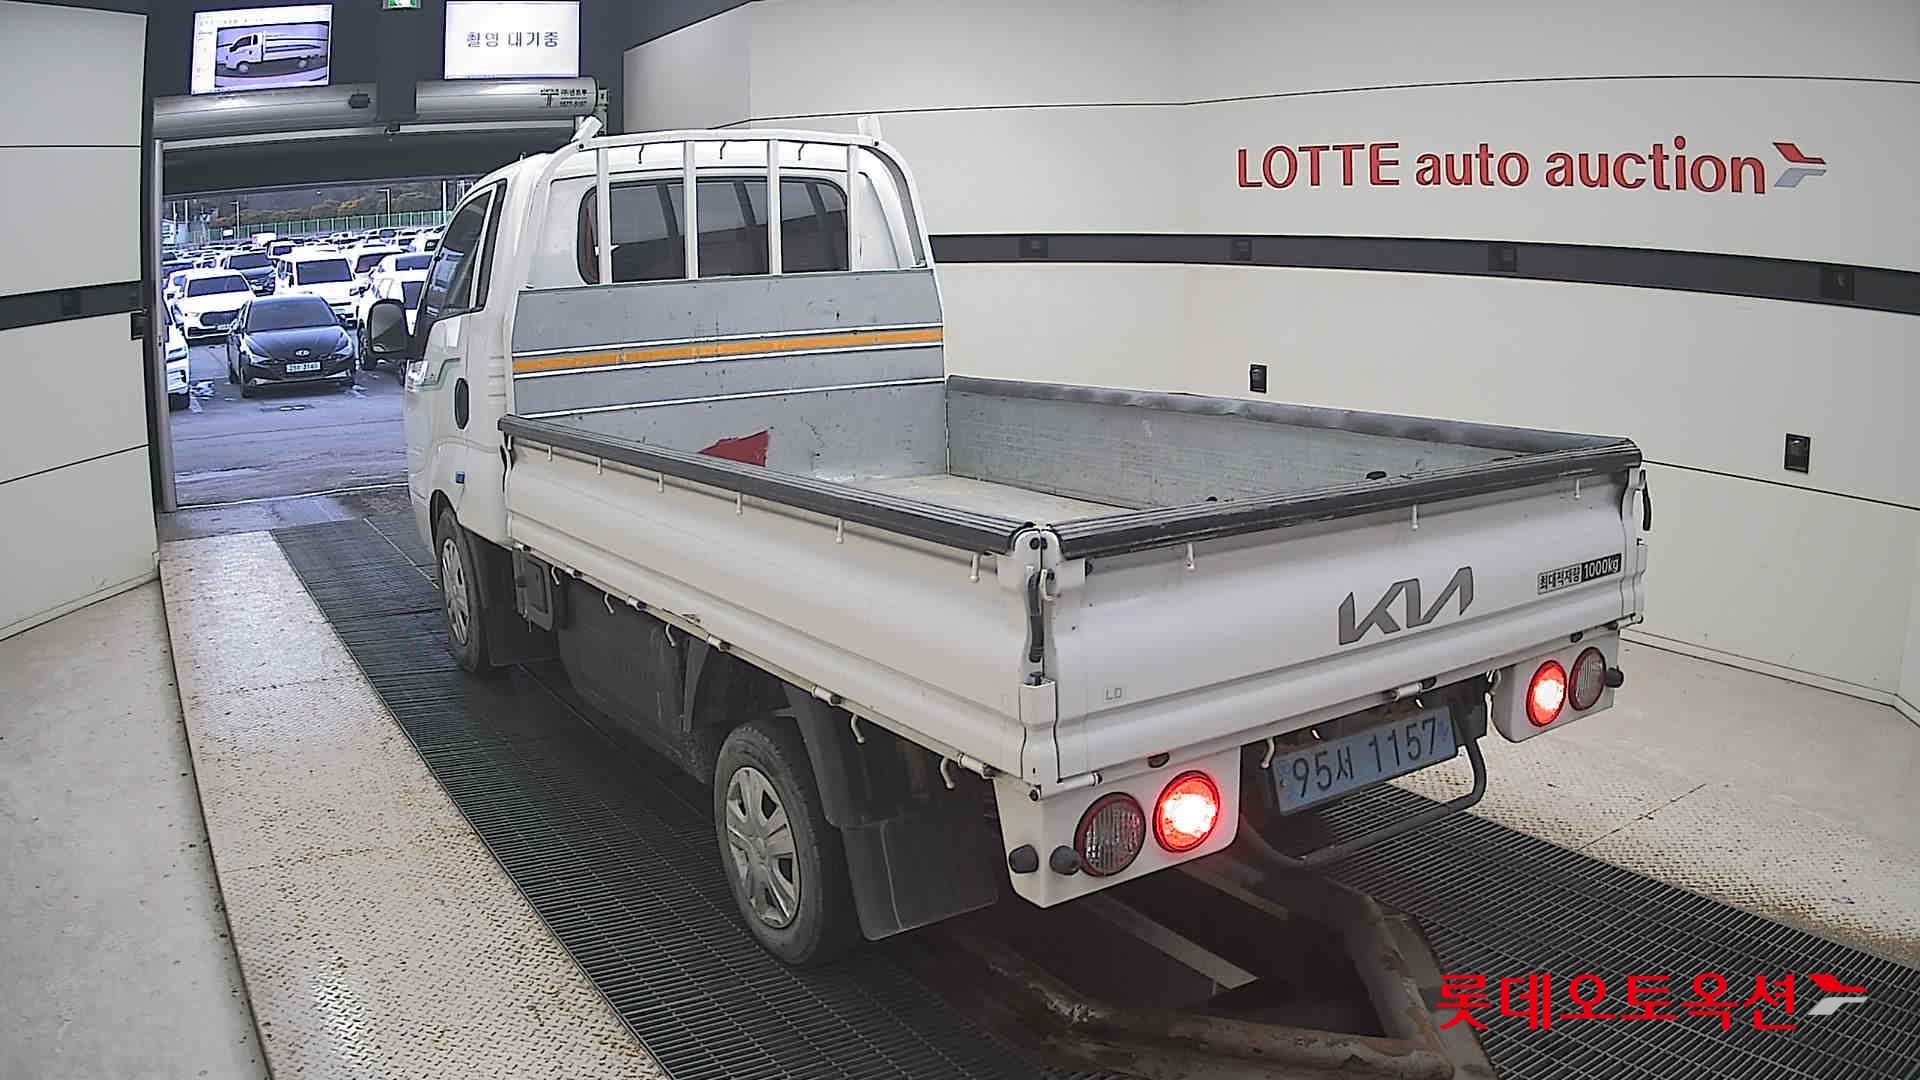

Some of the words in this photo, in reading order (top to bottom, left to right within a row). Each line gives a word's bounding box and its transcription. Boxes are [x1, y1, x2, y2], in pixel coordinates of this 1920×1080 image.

[507, 31, 559, 48] 대기중
[1238, 142, 1400, 189] LOTTE
[1416, 143, 1529, 187] auto
[1545, 135, 1766, 194] auction
[1539, 566, 1581, 591] 최대적재량
[1583, 556, 1620, 580] 1000kg
[1337, 565, 1475, 647] KIA
[1292, 750, 1355, 799] 95서
[1368, 715, 1437, 774] 1157
